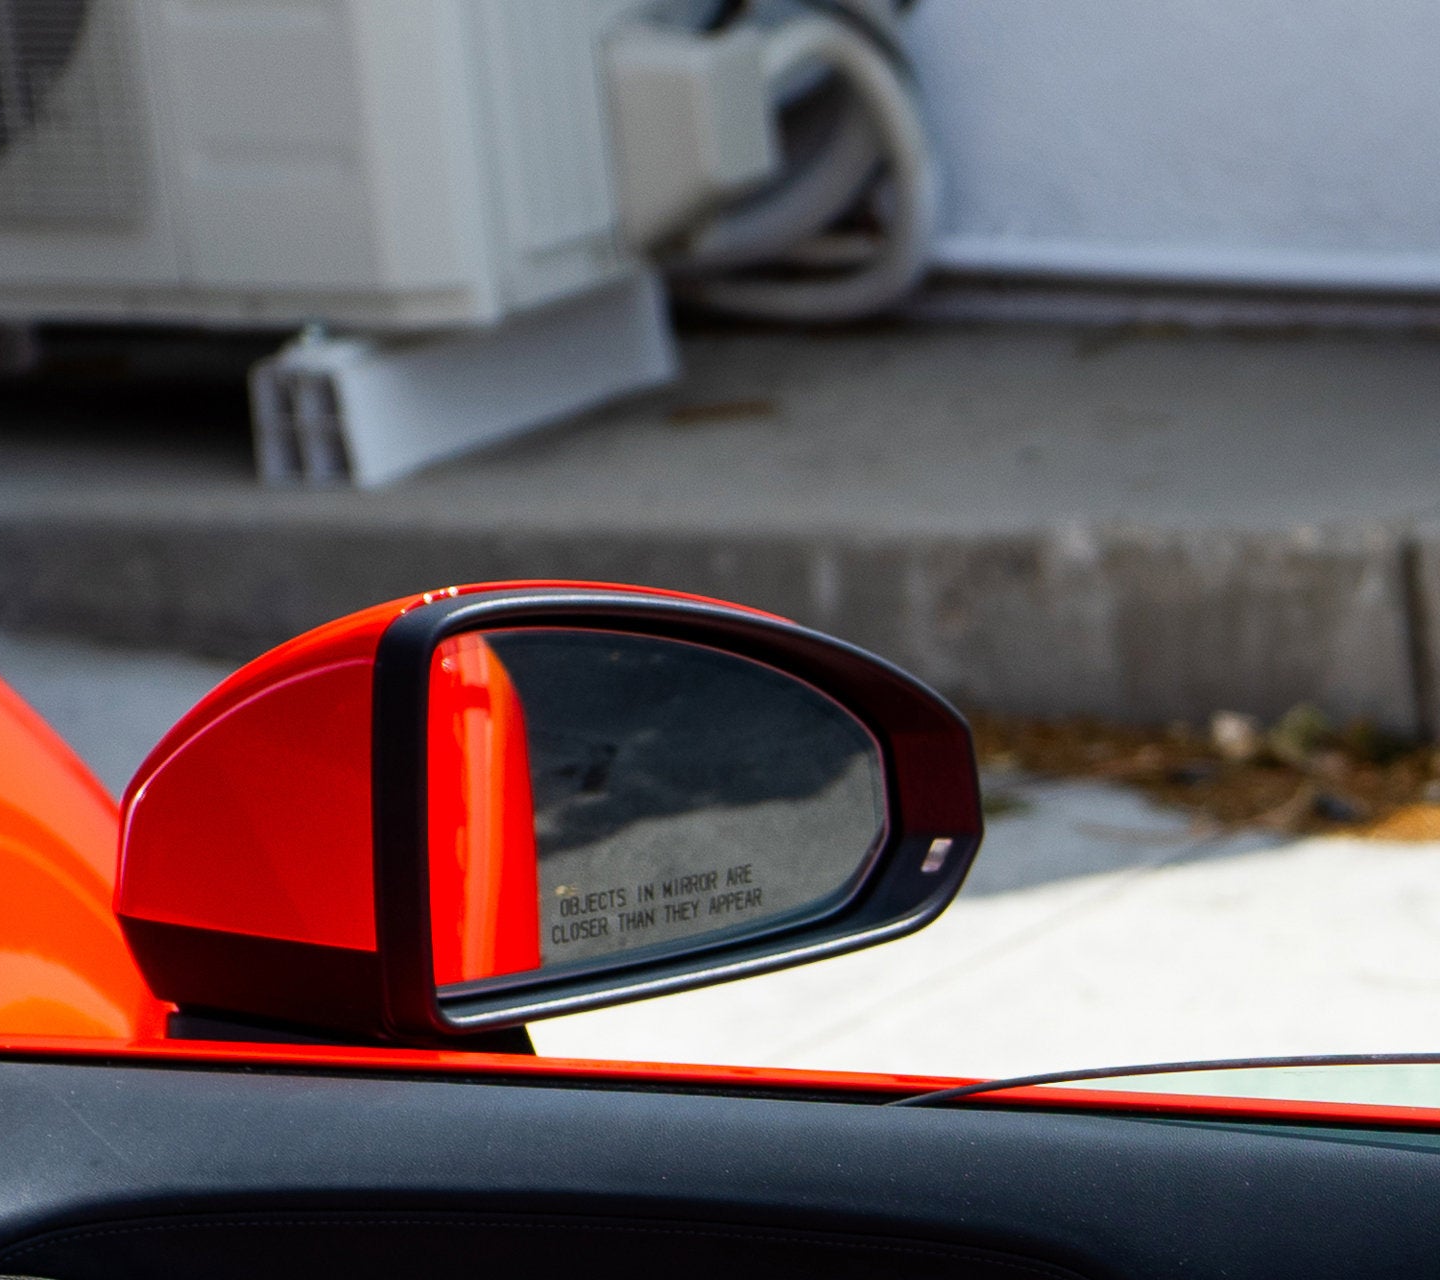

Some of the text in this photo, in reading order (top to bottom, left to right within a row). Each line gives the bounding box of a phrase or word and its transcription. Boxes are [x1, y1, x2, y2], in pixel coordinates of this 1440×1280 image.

[552, 887, 763, 945] CLOSER THAN THEY APPEAR
[560, 864, 753, 917] OBJECTS IN MIRROR ARE
